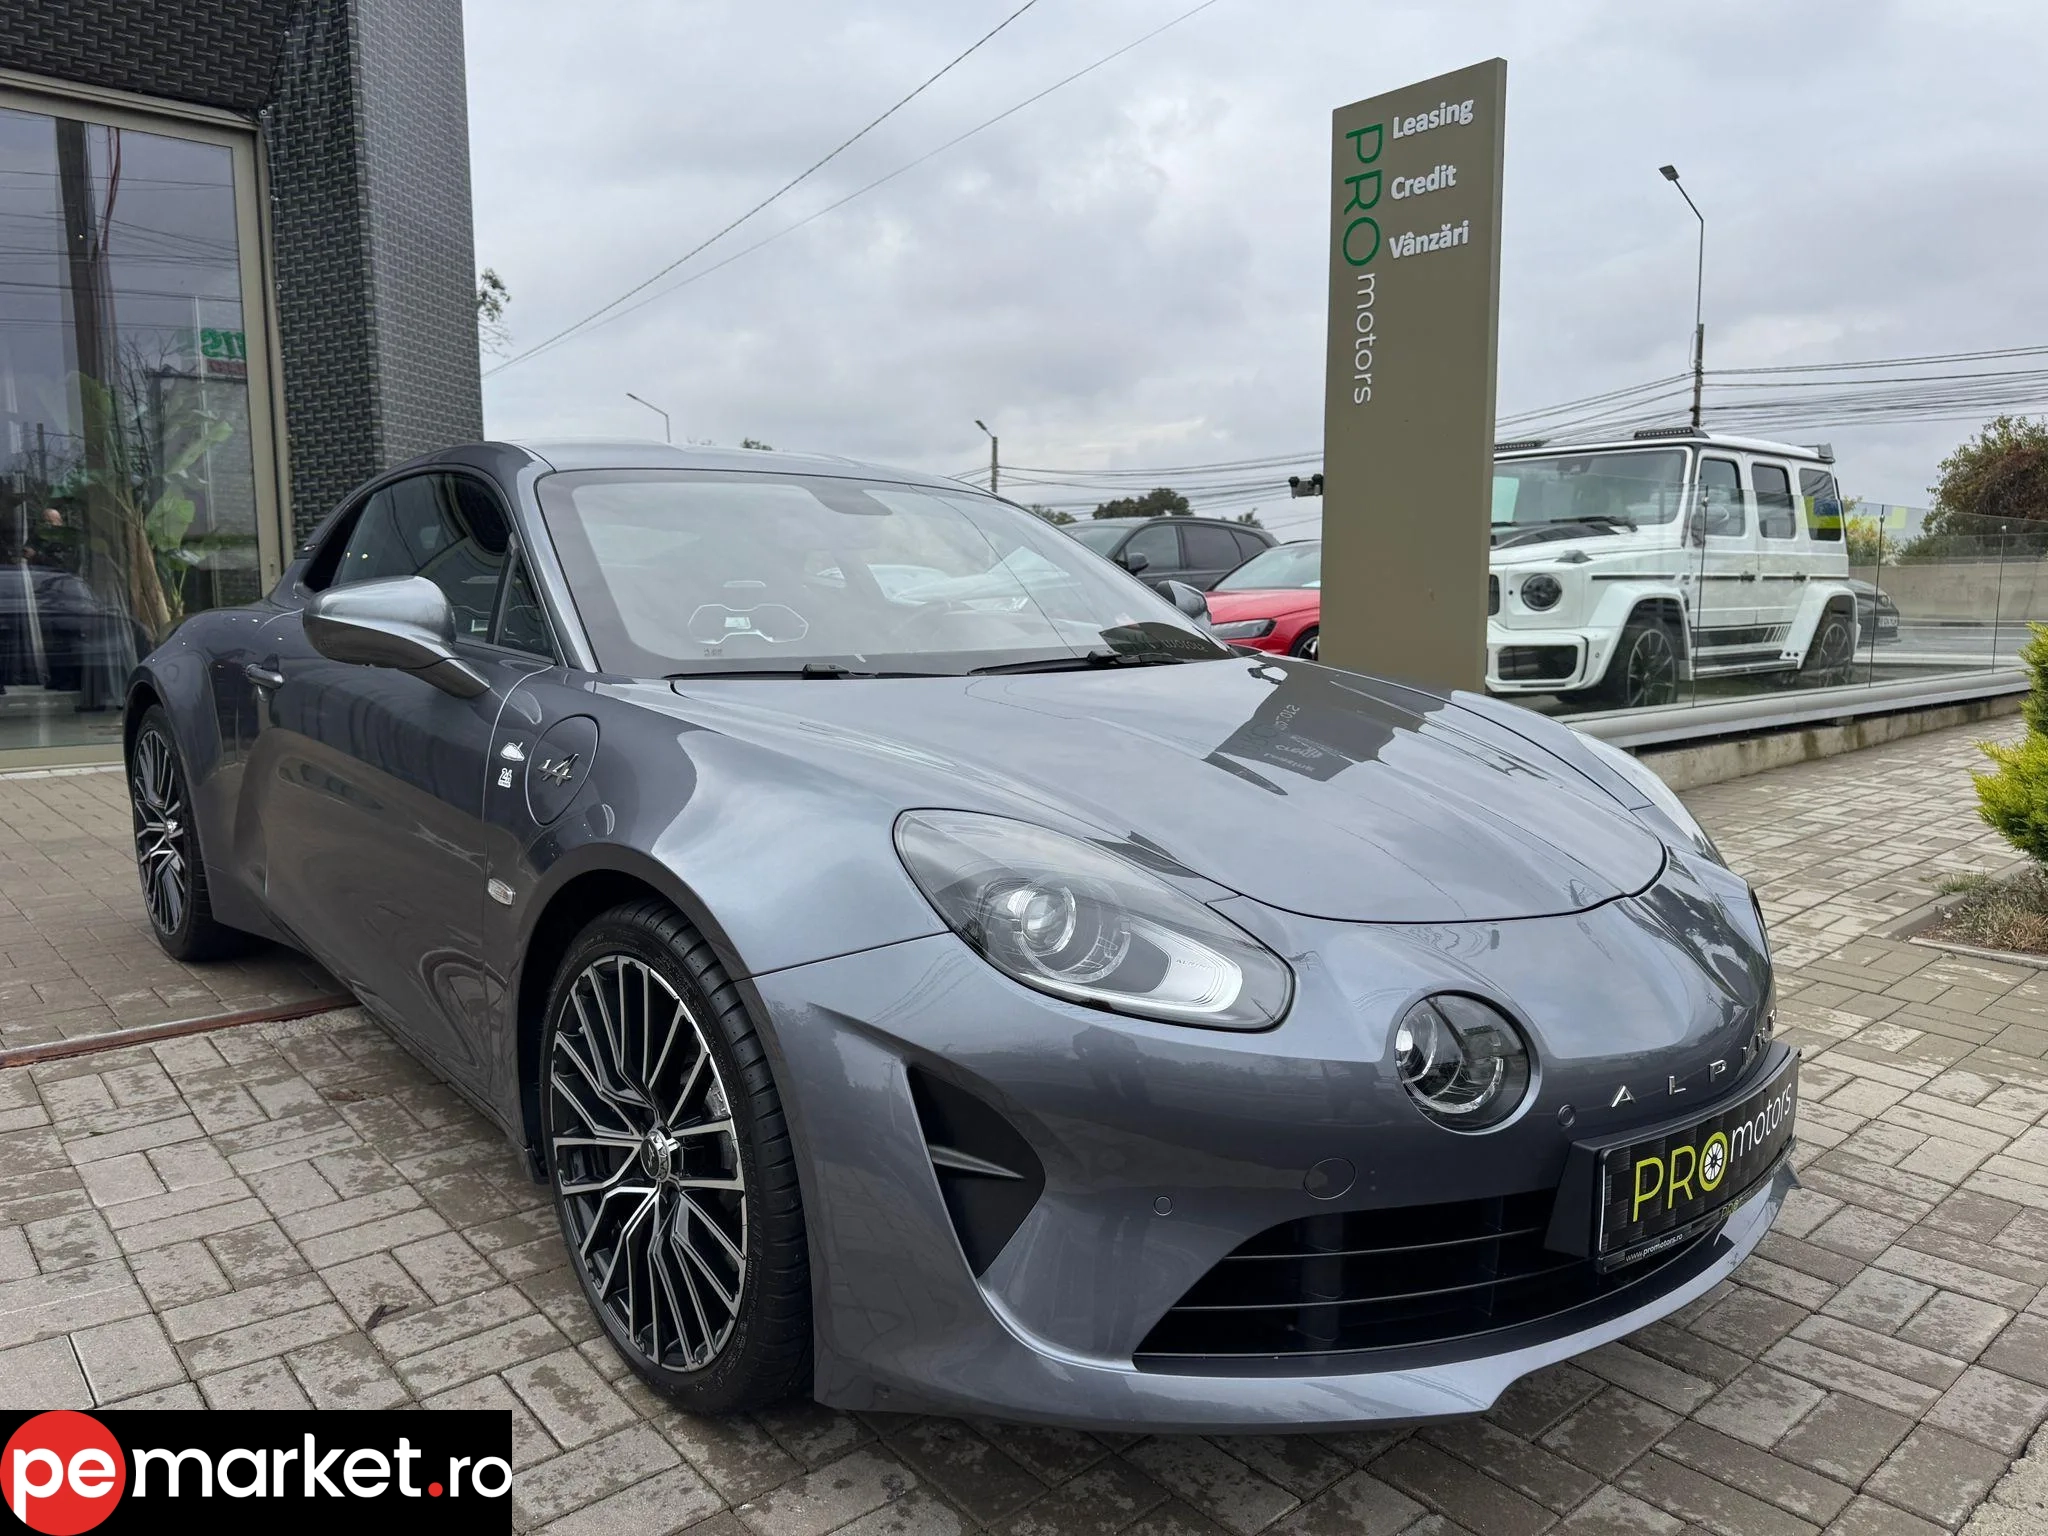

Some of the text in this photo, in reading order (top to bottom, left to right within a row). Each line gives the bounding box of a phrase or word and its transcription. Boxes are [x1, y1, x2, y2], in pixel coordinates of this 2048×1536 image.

[1393, 98, 1474, 139] Leasing
[1391, 165, 1457, 200] Credit
[1389, 221, 1470, 259] Vânzări
[1625, 1233, 1684, 1262] www.promotors.ro
